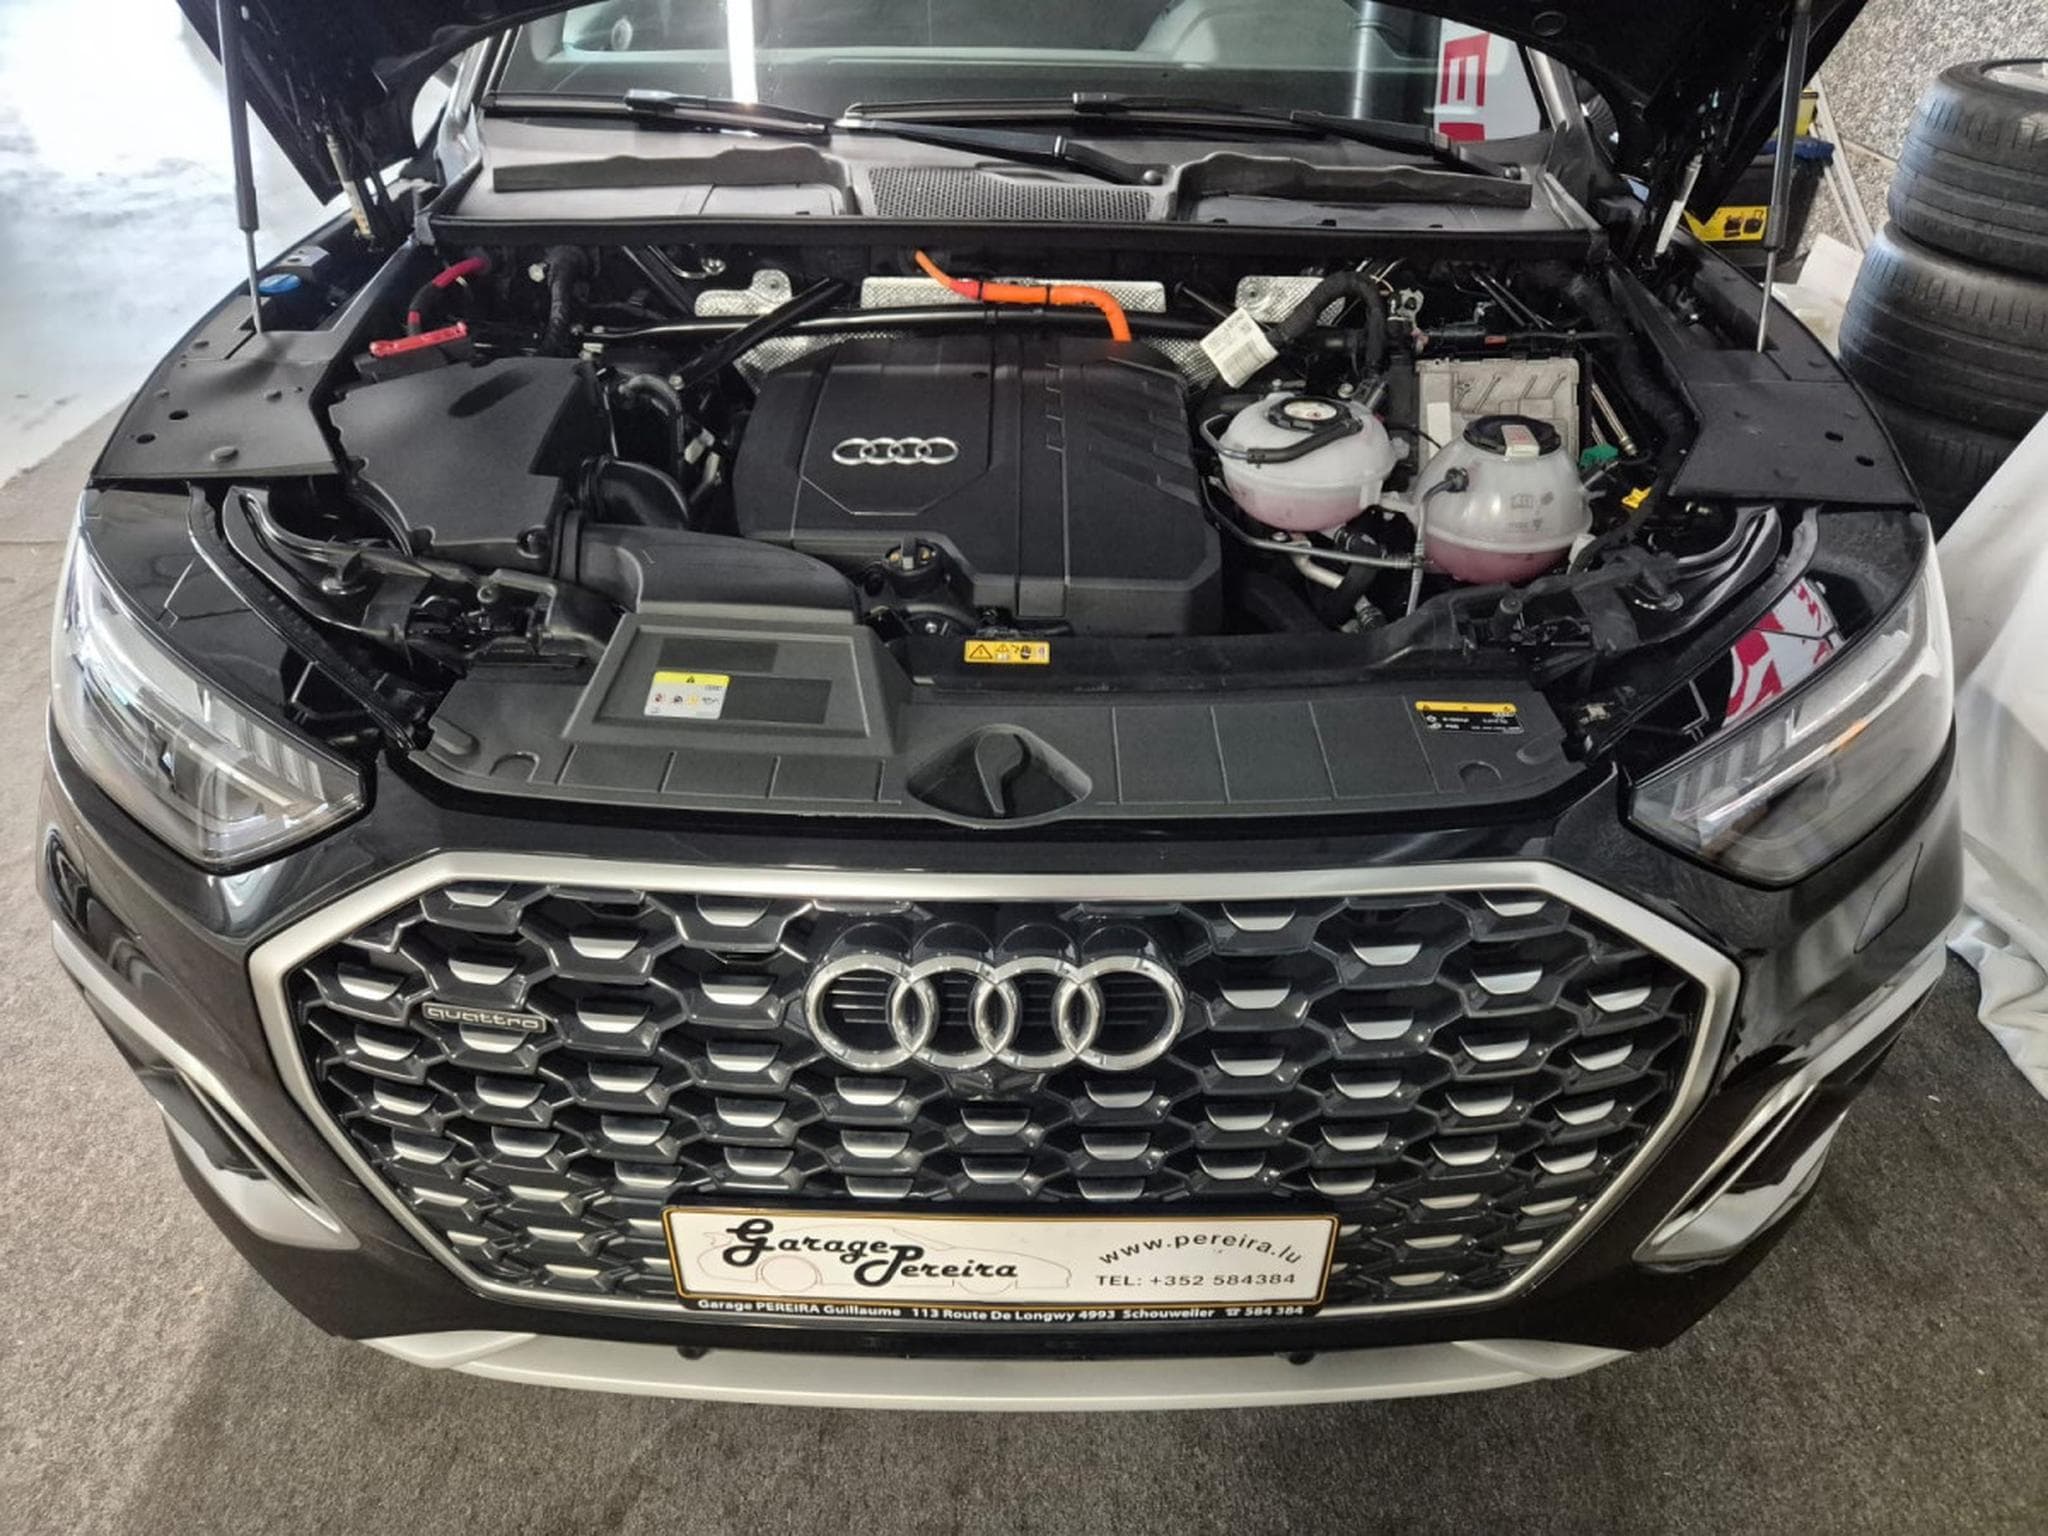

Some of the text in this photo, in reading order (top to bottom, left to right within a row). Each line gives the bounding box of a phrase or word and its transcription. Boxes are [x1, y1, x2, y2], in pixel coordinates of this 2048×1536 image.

[427, 1007, 539, 1029] quattro
[722, 1218, 888, 1268] Garage
[1099, 1233, 1303, 1265] www.pereira.lu
[854, 1244, 1019, 1287] Pereira
[1096, 1273, 1297, 1287] TEL: +352 584384
[698, 1300, 753, 1312] Garage
[756, 1303, 820, 1314] PEREIRA
[823, 1305, 901, 1317] Guillaume
[911, 1308, 940, 1318] 113
[943, 1309, 987, 1320] Route
[990, 1310, 1011, 1320] De
[1015, 1310, 1075, 1322] Longwy
[1078, 1310, 1116, 1319] 4993
[1244, 1307, 1272, 1316] 584
[1275, 1306, 1304, 1315] 384
